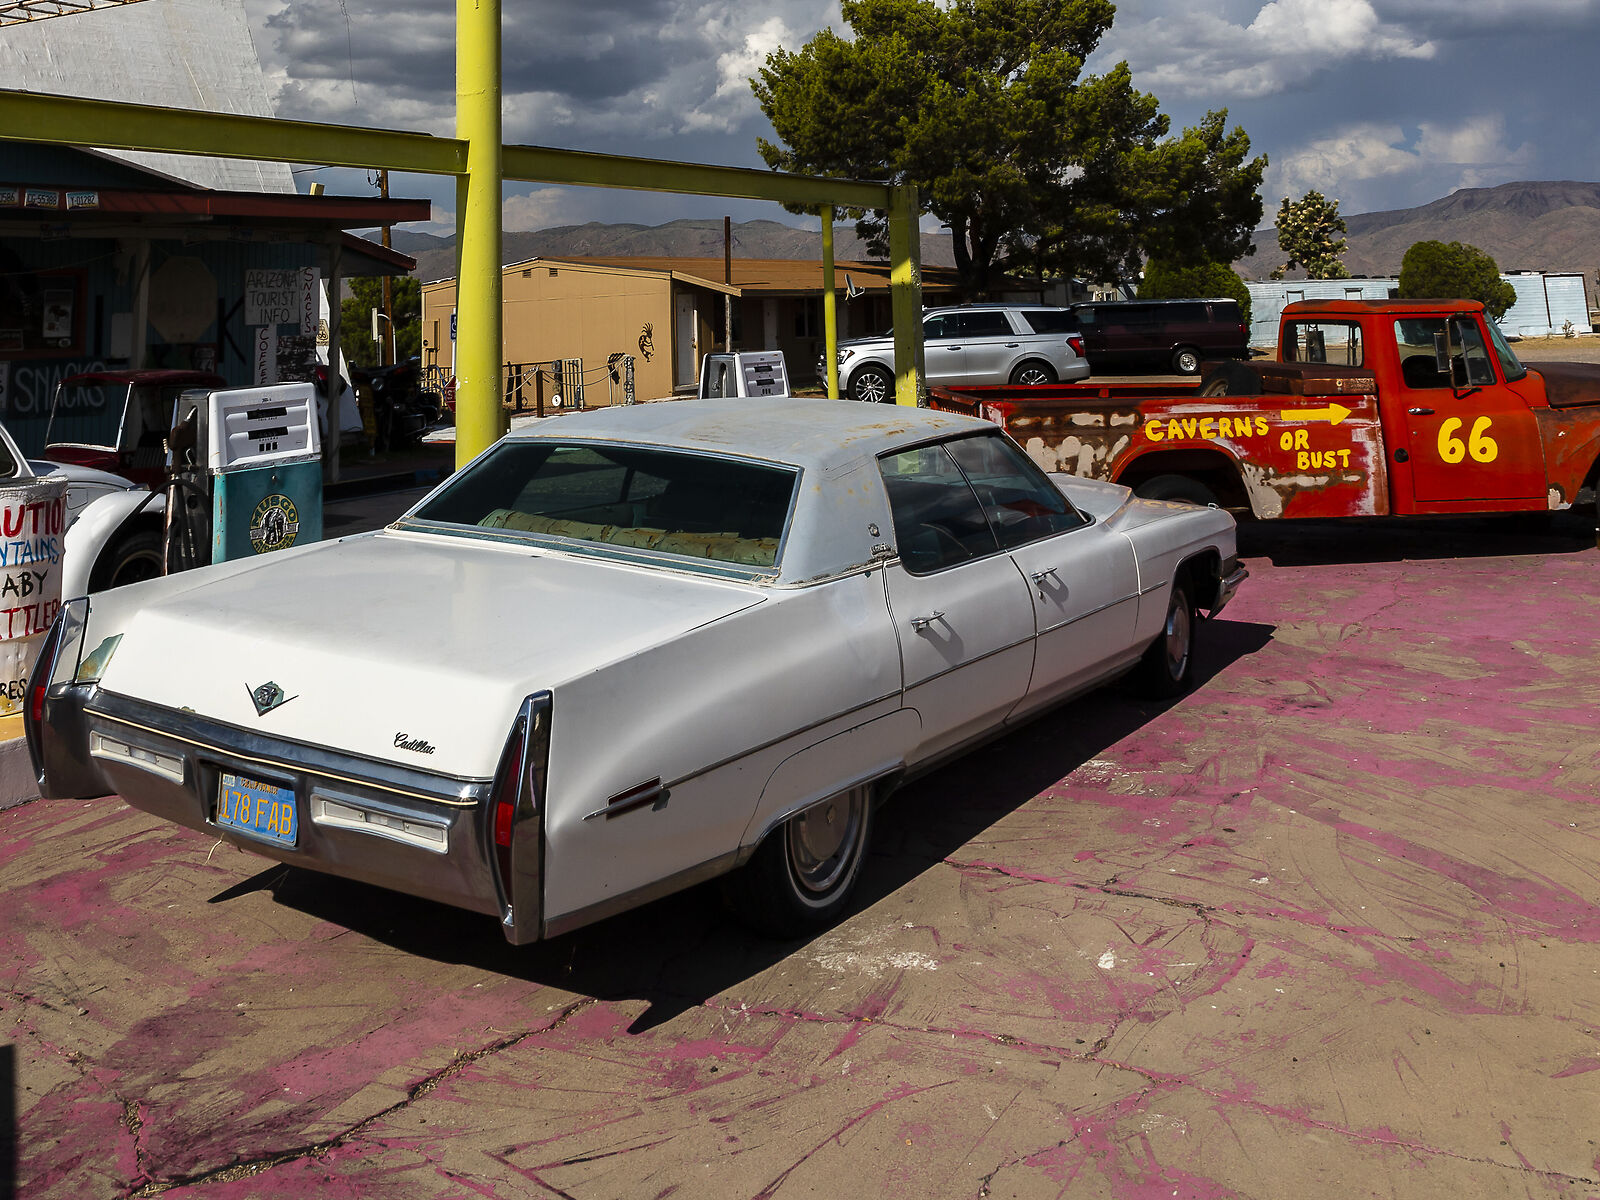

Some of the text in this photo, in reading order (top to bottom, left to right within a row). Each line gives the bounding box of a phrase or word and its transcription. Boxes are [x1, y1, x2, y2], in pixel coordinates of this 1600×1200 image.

[246, 270, 298, 289] ARIZONA
[250, 290, 296, 306] TOURIST
[260, 308, 290, 323] INFO
[14, 361, 106, 413] SNACKS
[1145, 416, 1269, 442] CAVERNS
[1280, 429, 1310, 452] OR
[1437, 415, 1499, 464] 66
[1297, 448, 1351, 470] BUST
[250, 495, 298, 527] MUSGO
[393, 731, 436, 755] Cadillac
[221, 789, 293, 835] 178 FAB
